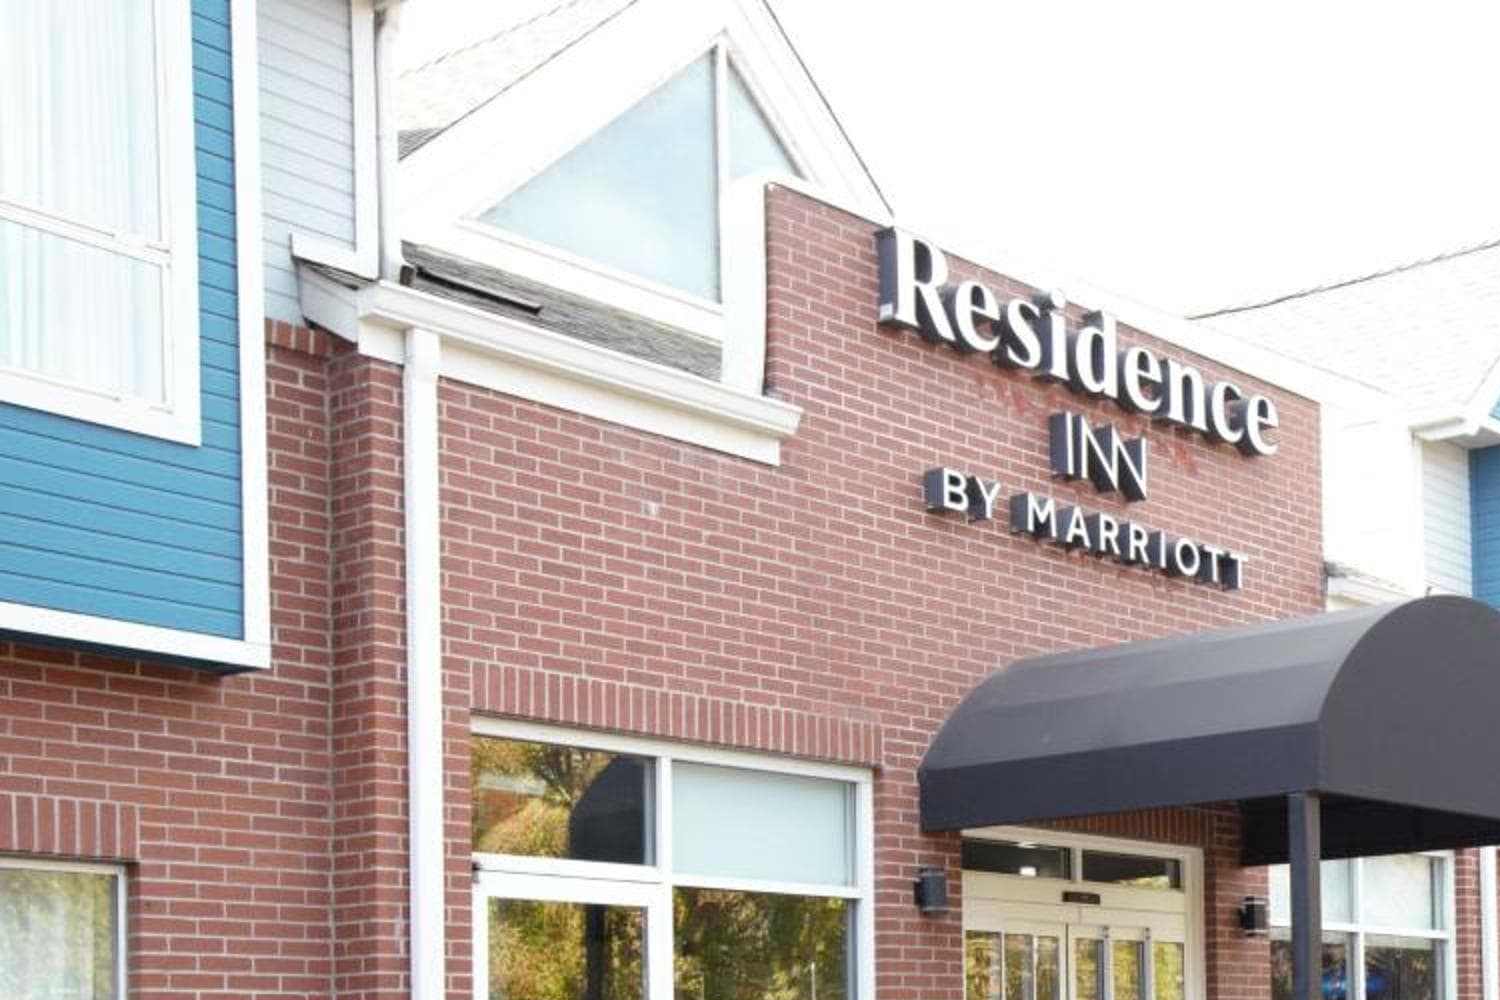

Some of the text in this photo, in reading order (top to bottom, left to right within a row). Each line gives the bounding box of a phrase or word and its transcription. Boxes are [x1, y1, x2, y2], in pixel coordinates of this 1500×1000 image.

[886, 228, 1280, 456] Residence
[1060, 411, 1147, 500] INN
[936, 467, 1248, 589] BY MARRIOTT
